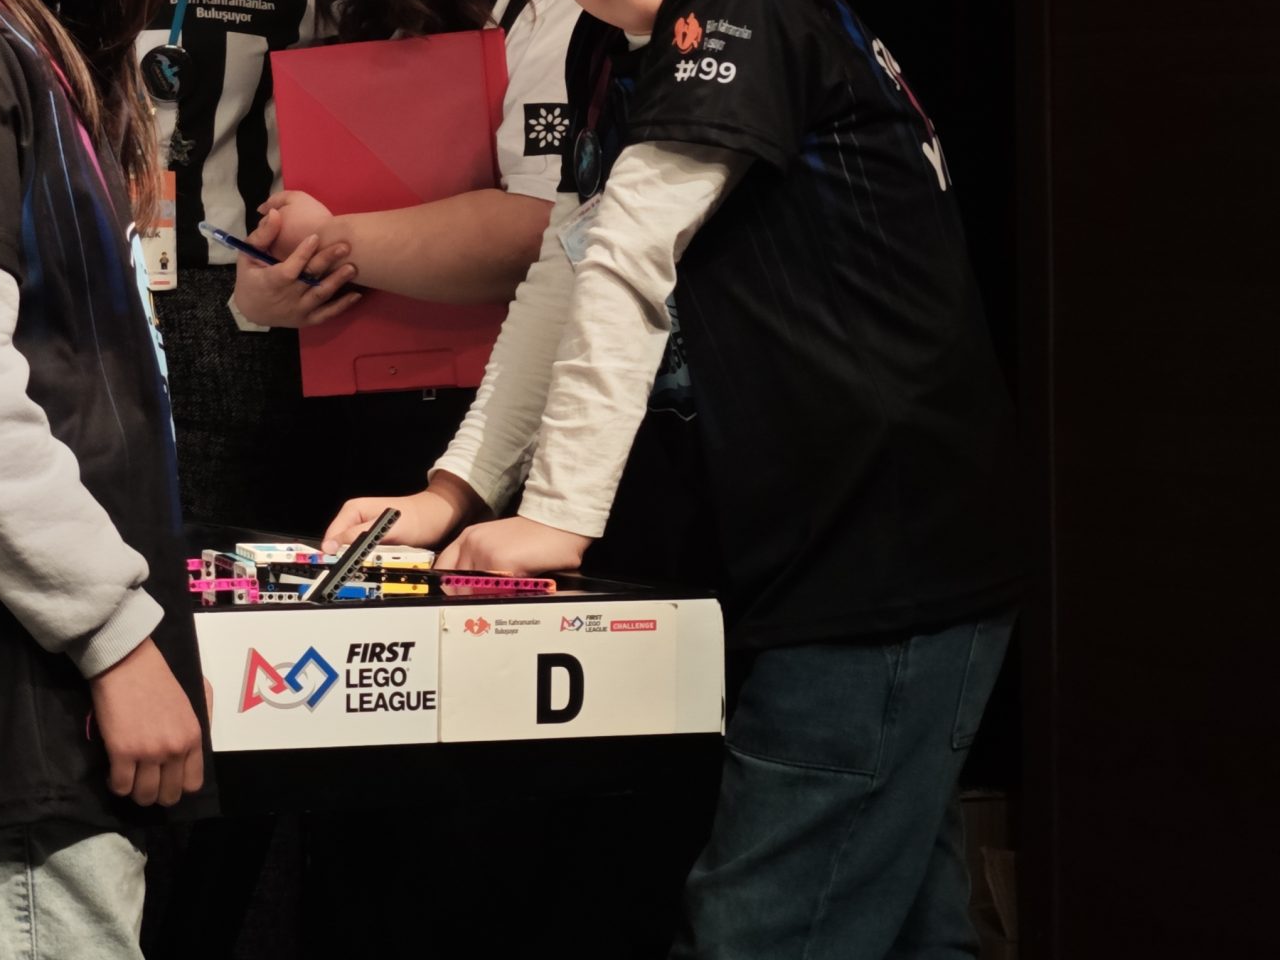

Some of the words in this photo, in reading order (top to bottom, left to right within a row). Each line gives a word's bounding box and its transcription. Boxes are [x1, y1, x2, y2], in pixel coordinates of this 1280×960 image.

[346, 641, 416, 664] FIRST
[345, 667, 407, 688] LEGO
[536, 652, 585, 725] D
[346, 690, 437, 713] LEAGUE
